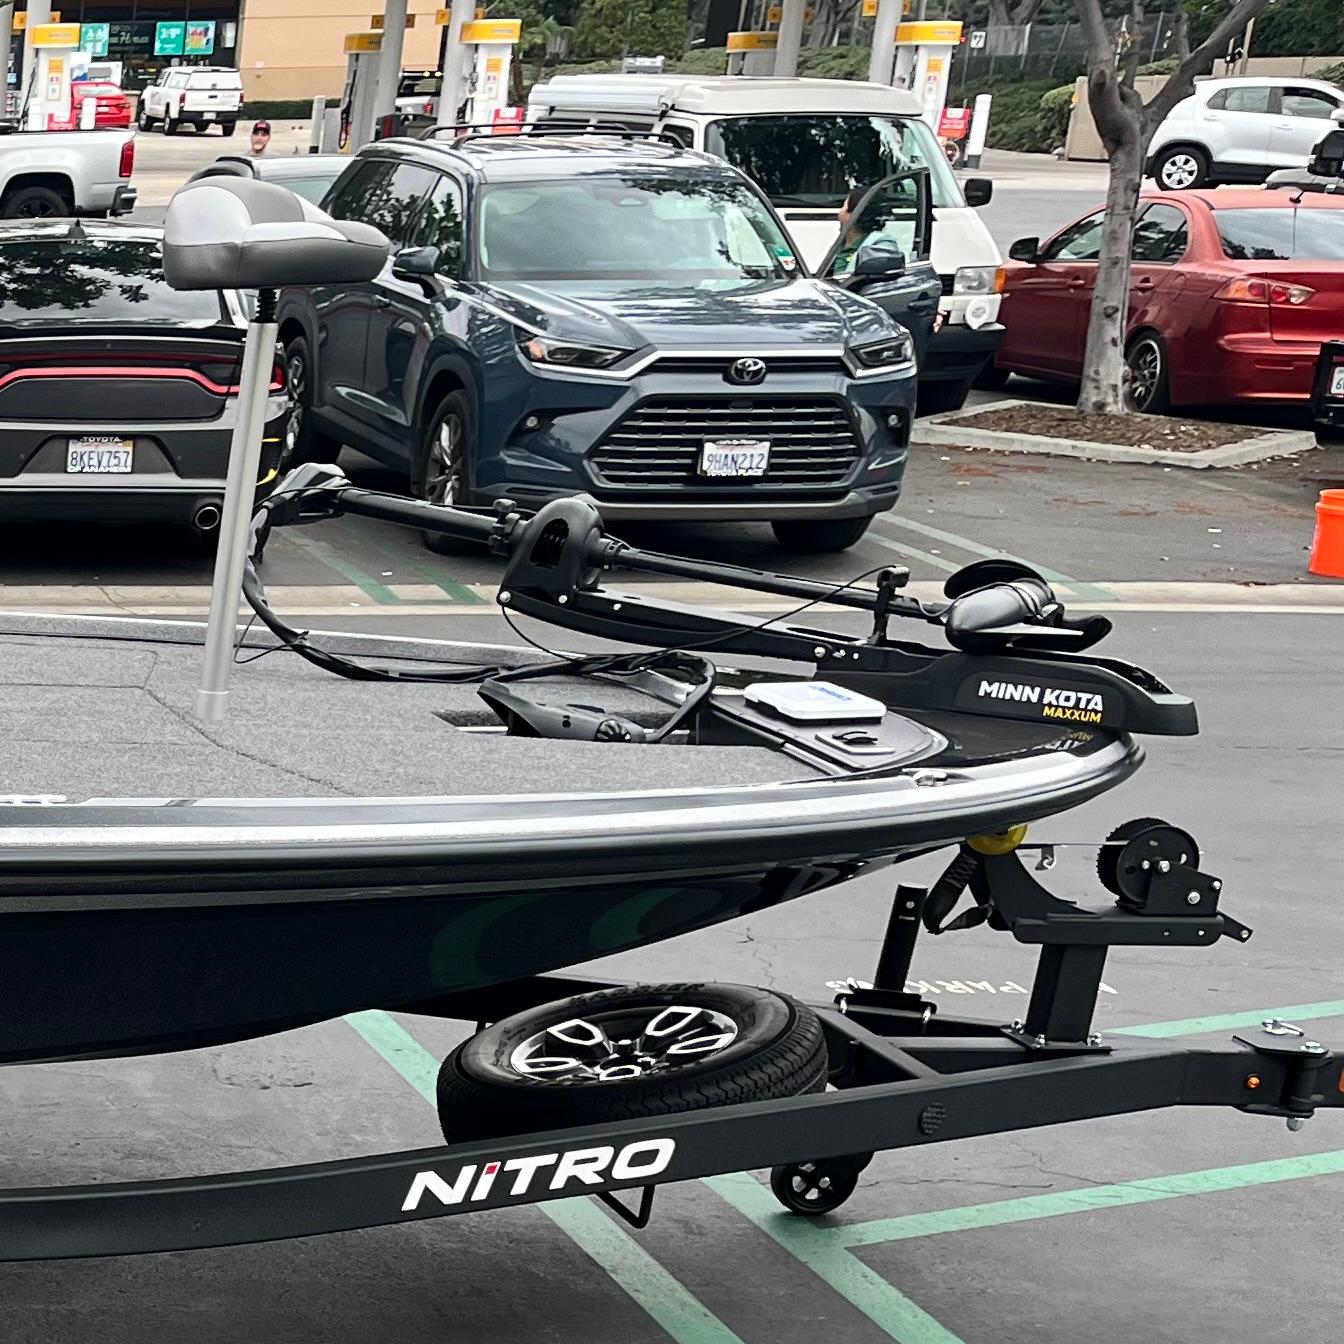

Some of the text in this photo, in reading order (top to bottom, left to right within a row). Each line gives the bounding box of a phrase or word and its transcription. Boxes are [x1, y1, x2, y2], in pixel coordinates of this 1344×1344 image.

[70, 450, 130, 468] 8KEV757
[707, 453, 765, 471] 9HAN212
[978, 680, 1104, 711] MINN KOTA
[1042, 705, 1102, 723] MAXXUM
